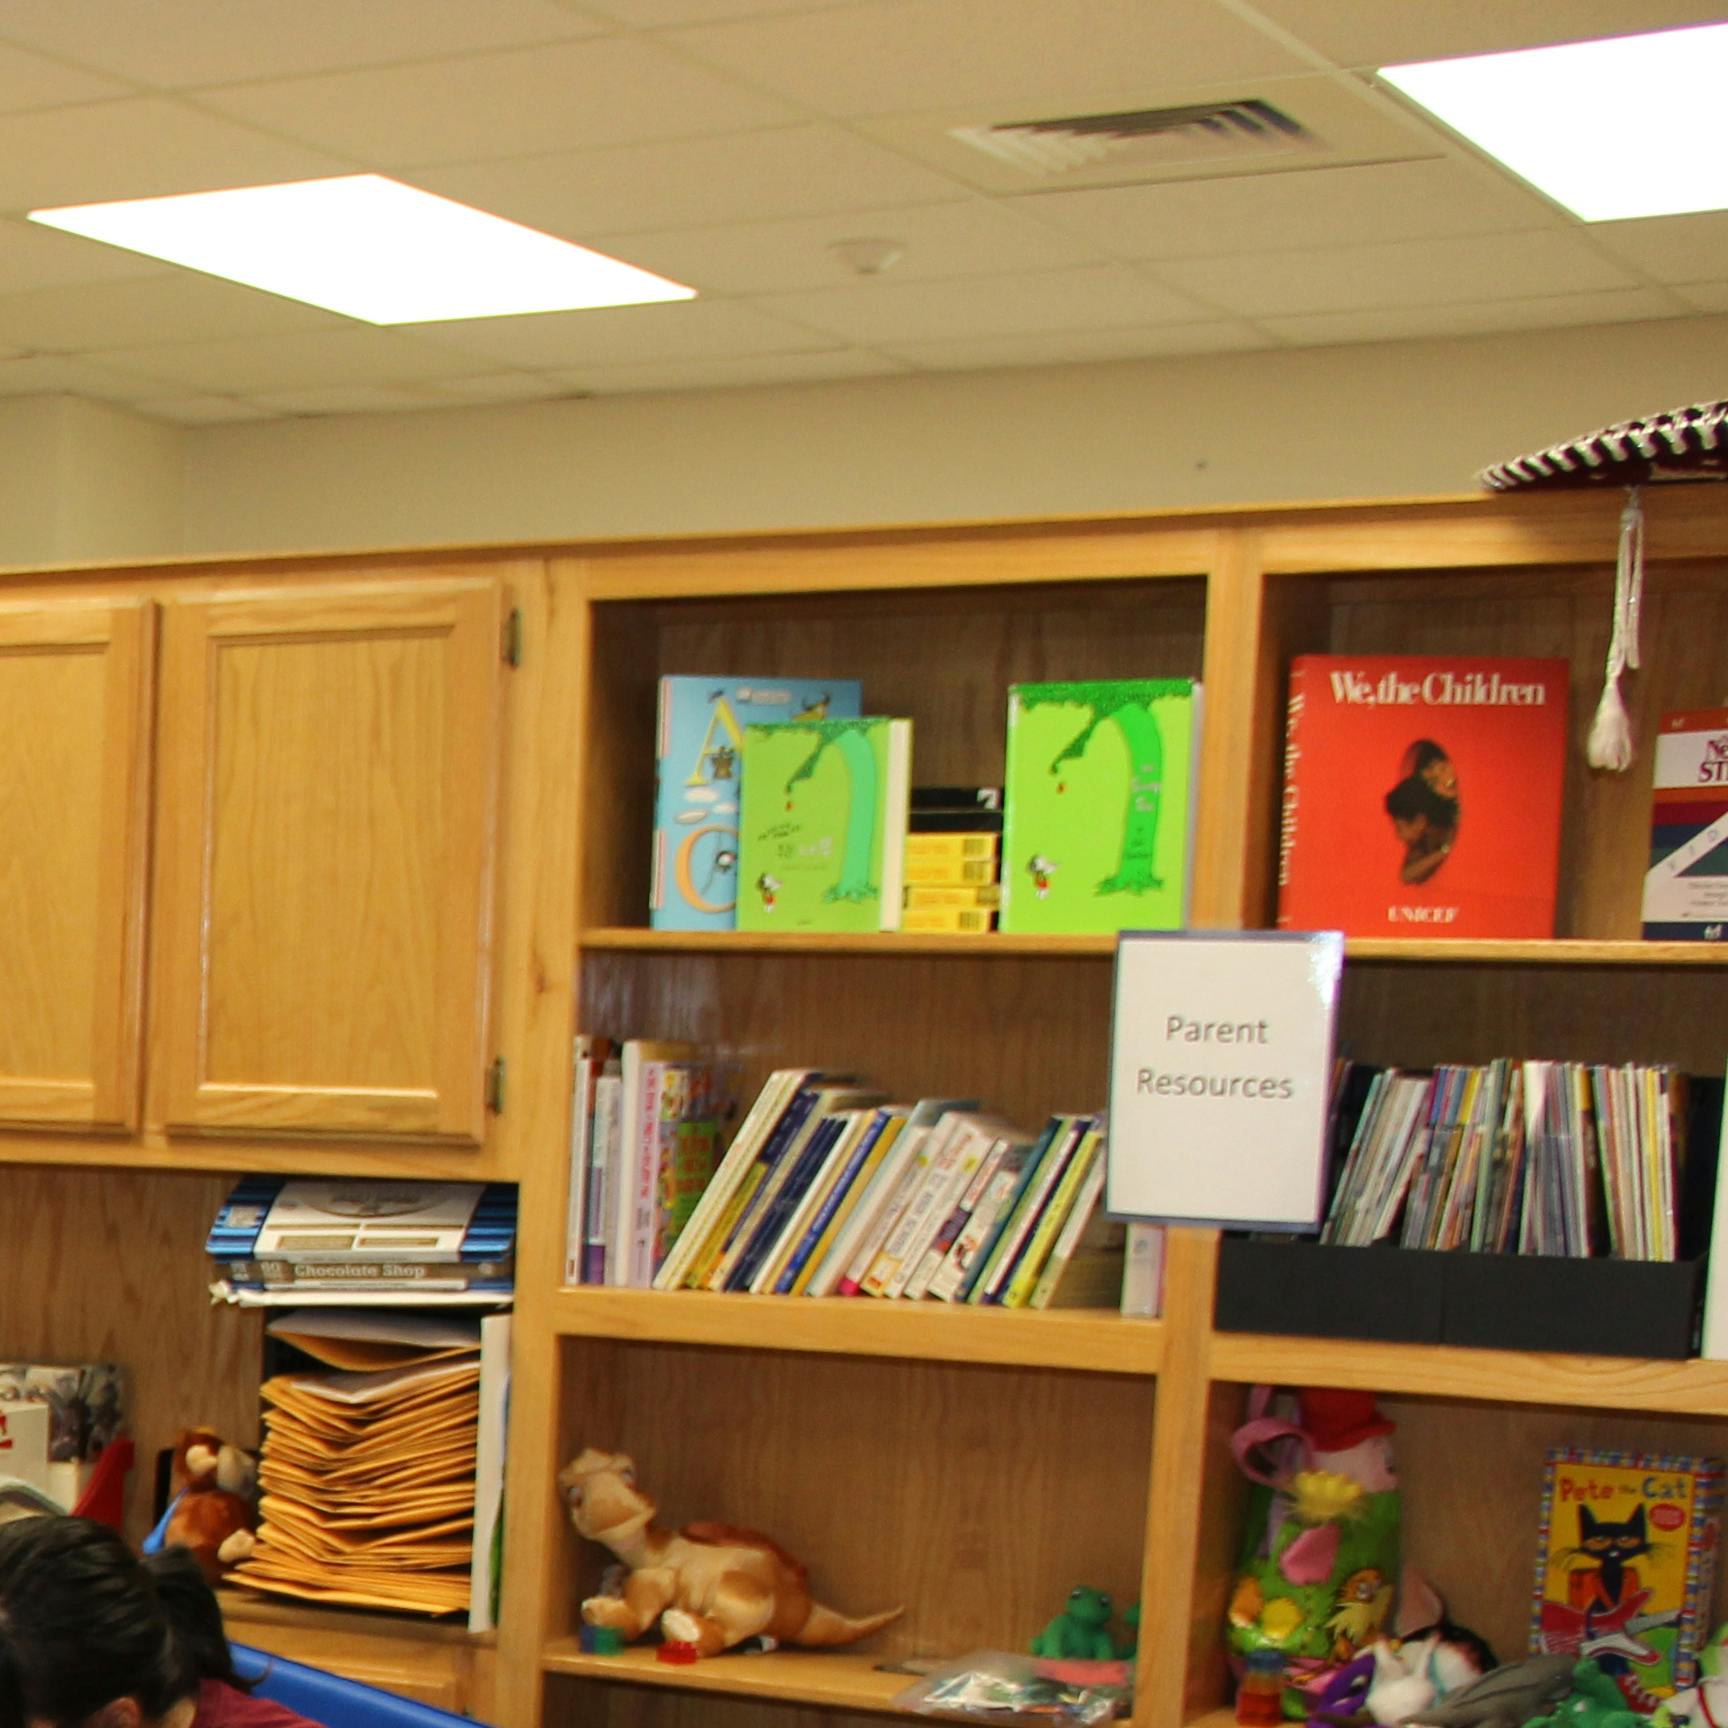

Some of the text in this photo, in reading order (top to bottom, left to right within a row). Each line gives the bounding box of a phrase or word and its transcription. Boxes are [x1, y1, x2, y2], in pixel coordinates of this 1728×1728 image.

[1378, 671, 1421, 704] the
[1422, 671, 1545, 705] Children
[1387, 905, 1459, 923] UNICEF
[1165, 1015, 1269, 1045] Parent
[1136, 1067, 1294, 1100] Resources
[294, 1262, 378, 1278] Chocolate
[382, 1262, 426, 1279] Shop
[1559, 1476, 1614, 1502] Pete
[1641, 1475, 1688, 1500] Cat
